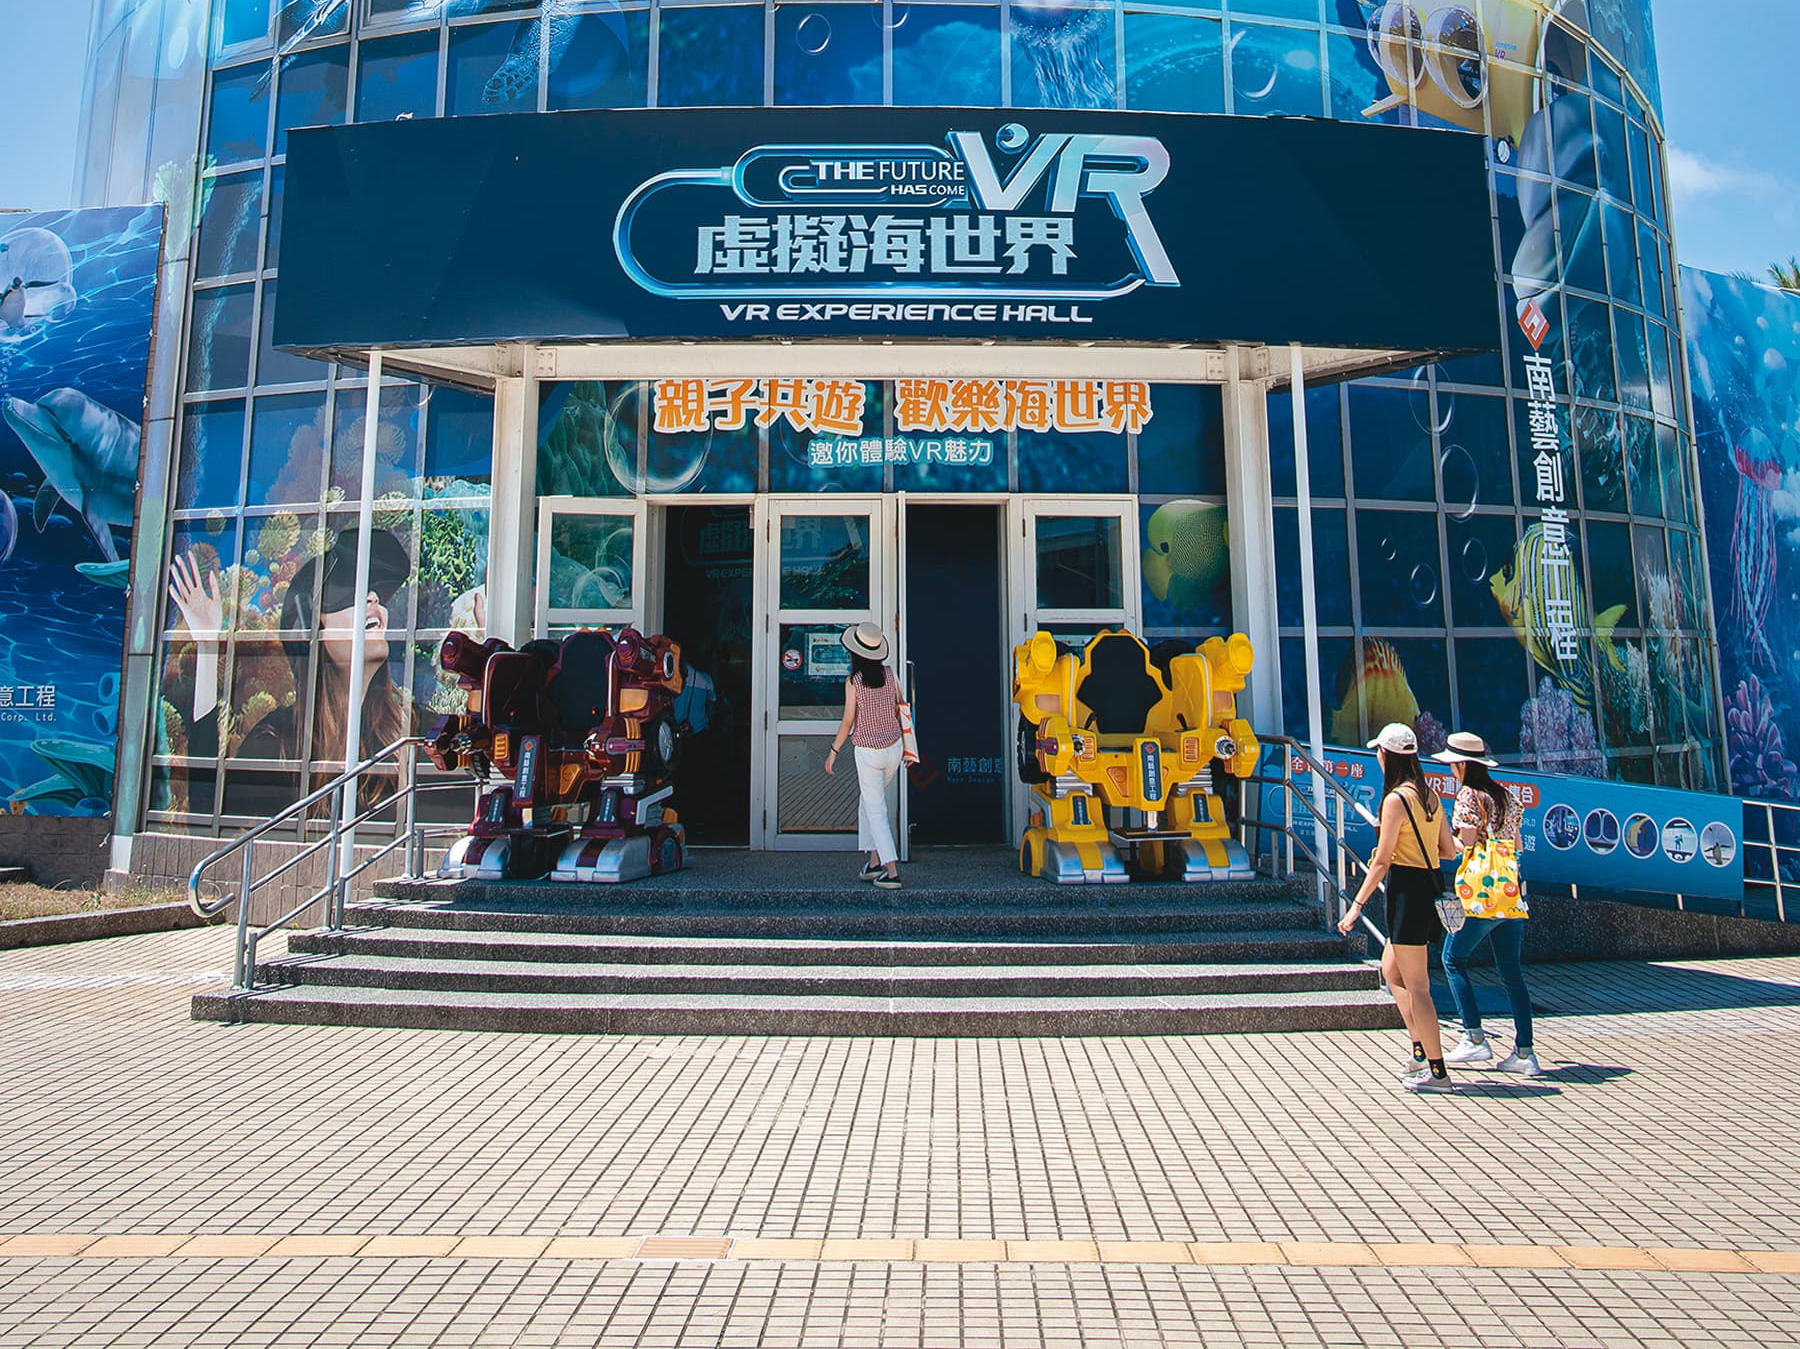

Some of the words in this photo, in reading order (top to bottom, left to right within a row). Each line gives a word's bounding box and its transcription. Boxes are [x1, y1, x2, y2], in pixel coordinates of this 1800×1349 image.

[811, 161, 874, 180] THE
[879, 161, 965, 181] FUTURE
[890, 184, 927, 195] HAS
[929, 184, 965, 196] COME
[944, 129, 1181, 288] VR
[694, 214, 1078, 276] 虛擬海世界
[719, 304, 770, 321] VR
[776, 303, 997, 322] EXPERIENCE
[1001, 305, 1094, 323] HALL
[654, 379, 865, 436] 親子共遊
[894, 379, 1153, 434] 歡樂海世界
[810, 439, 992, 466] 邀你體驗VR魅力
[1523, 352, 1578, 661] 南藝創意工程
[0, 685, 56, 707] 意工程
[36, 712, 57, 722] Ltd.
